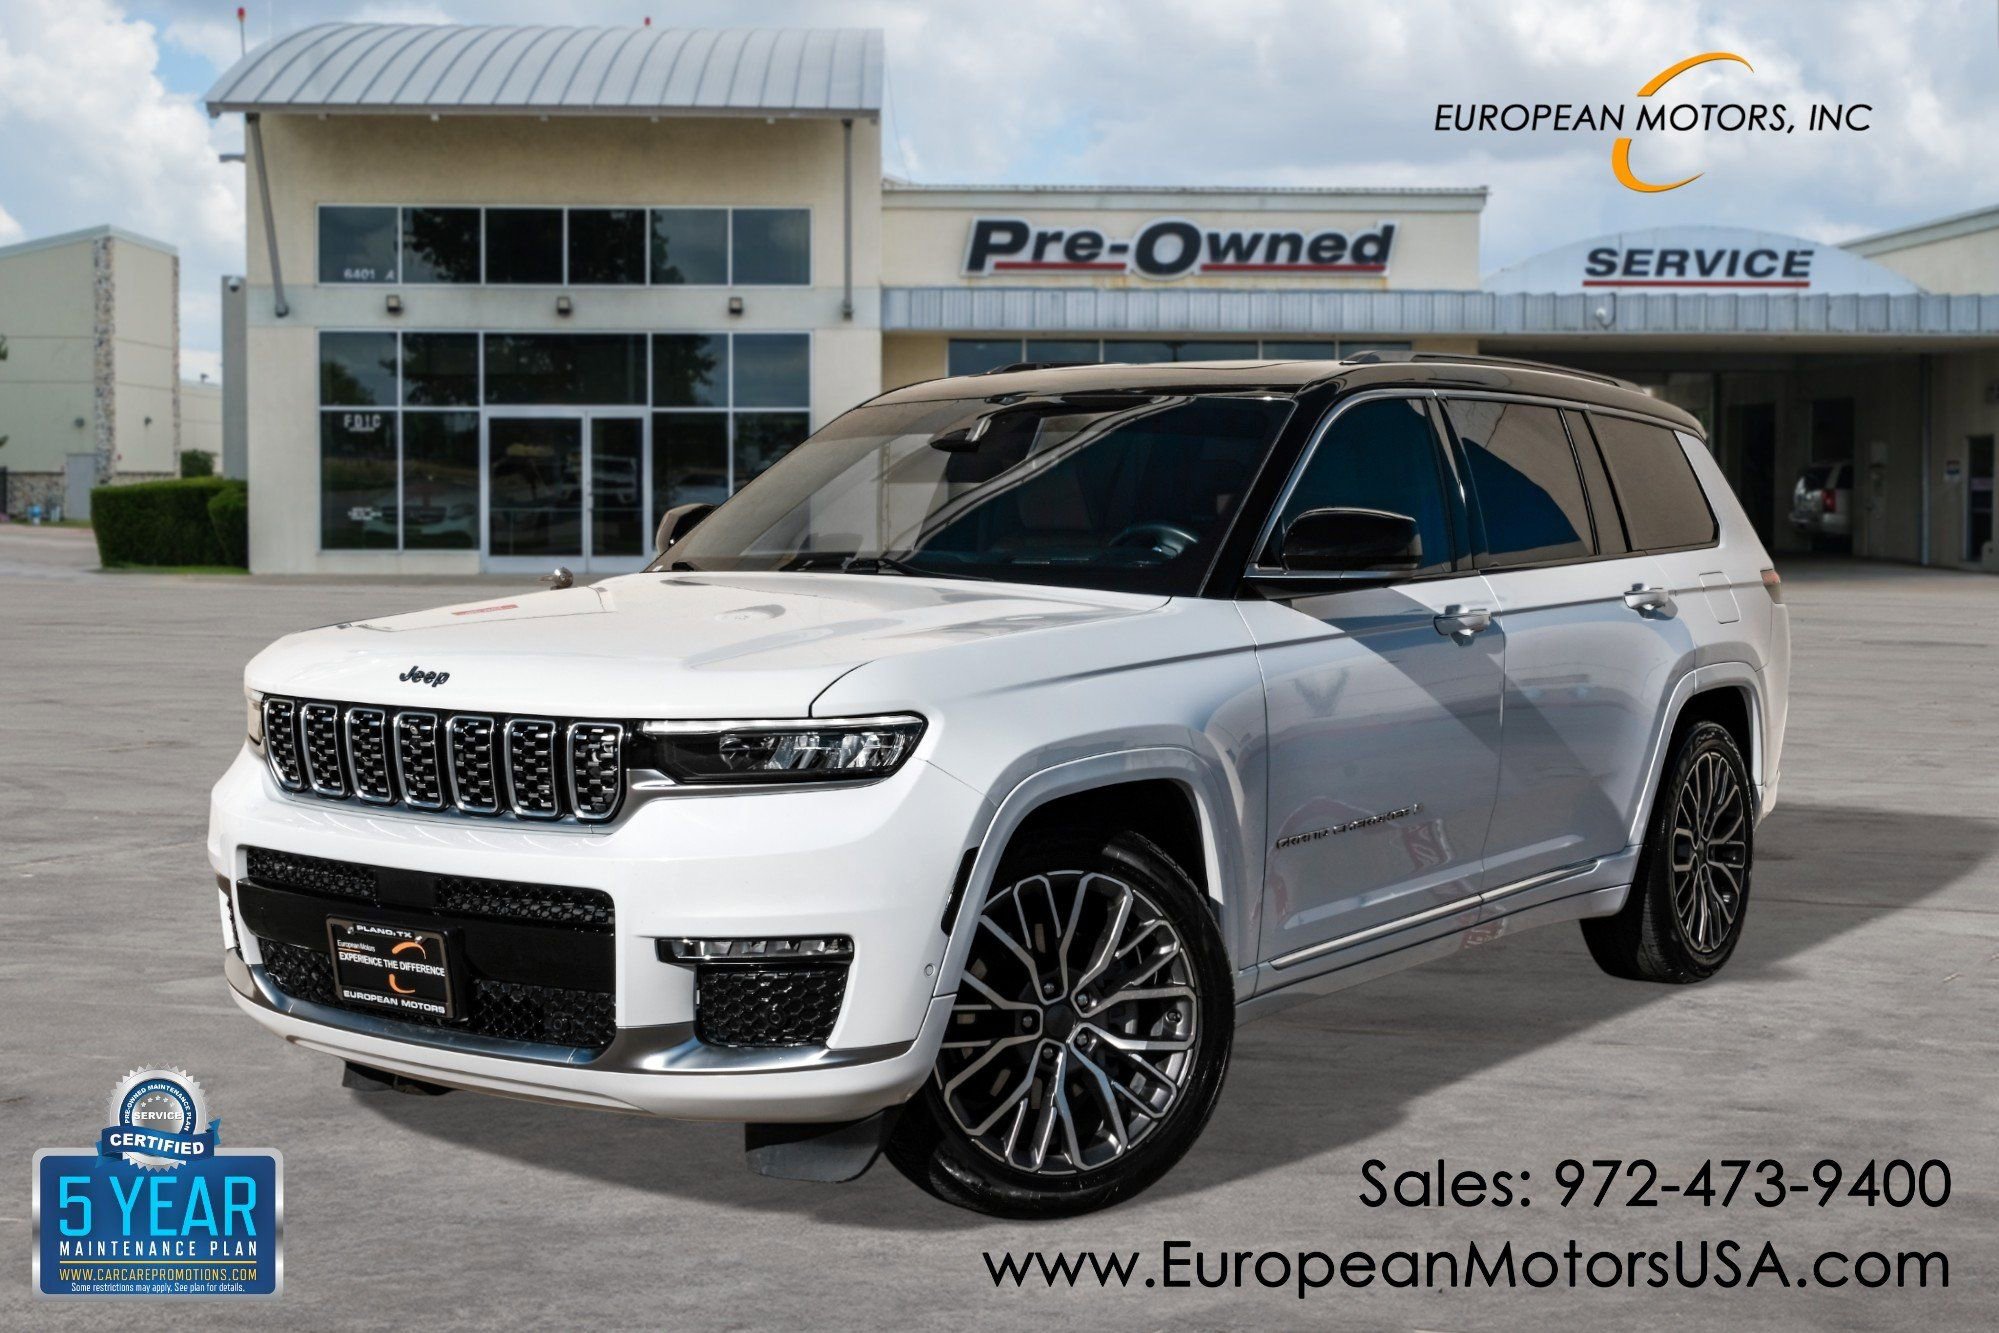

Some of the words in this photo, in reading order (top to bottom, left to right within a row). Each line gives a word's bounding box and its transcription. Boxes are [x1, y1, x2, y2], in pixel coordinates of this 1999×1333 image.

[966, 219, 1395, 275] Pre-Owned
[1585, 248, 1814, 278] SERVICE
[399, 665, 450, 687] Jeep
[396, 930, 412, 939] TX
[338, 951, 383, 968] EXPERIENCE
[383, 959, 399, 970] THE
[400, 961, 446, 977] DIFFERENCE
[343, 989, 398, 1006] EUROPEAN
[401, 1000, 446, 1014] MOTORS
